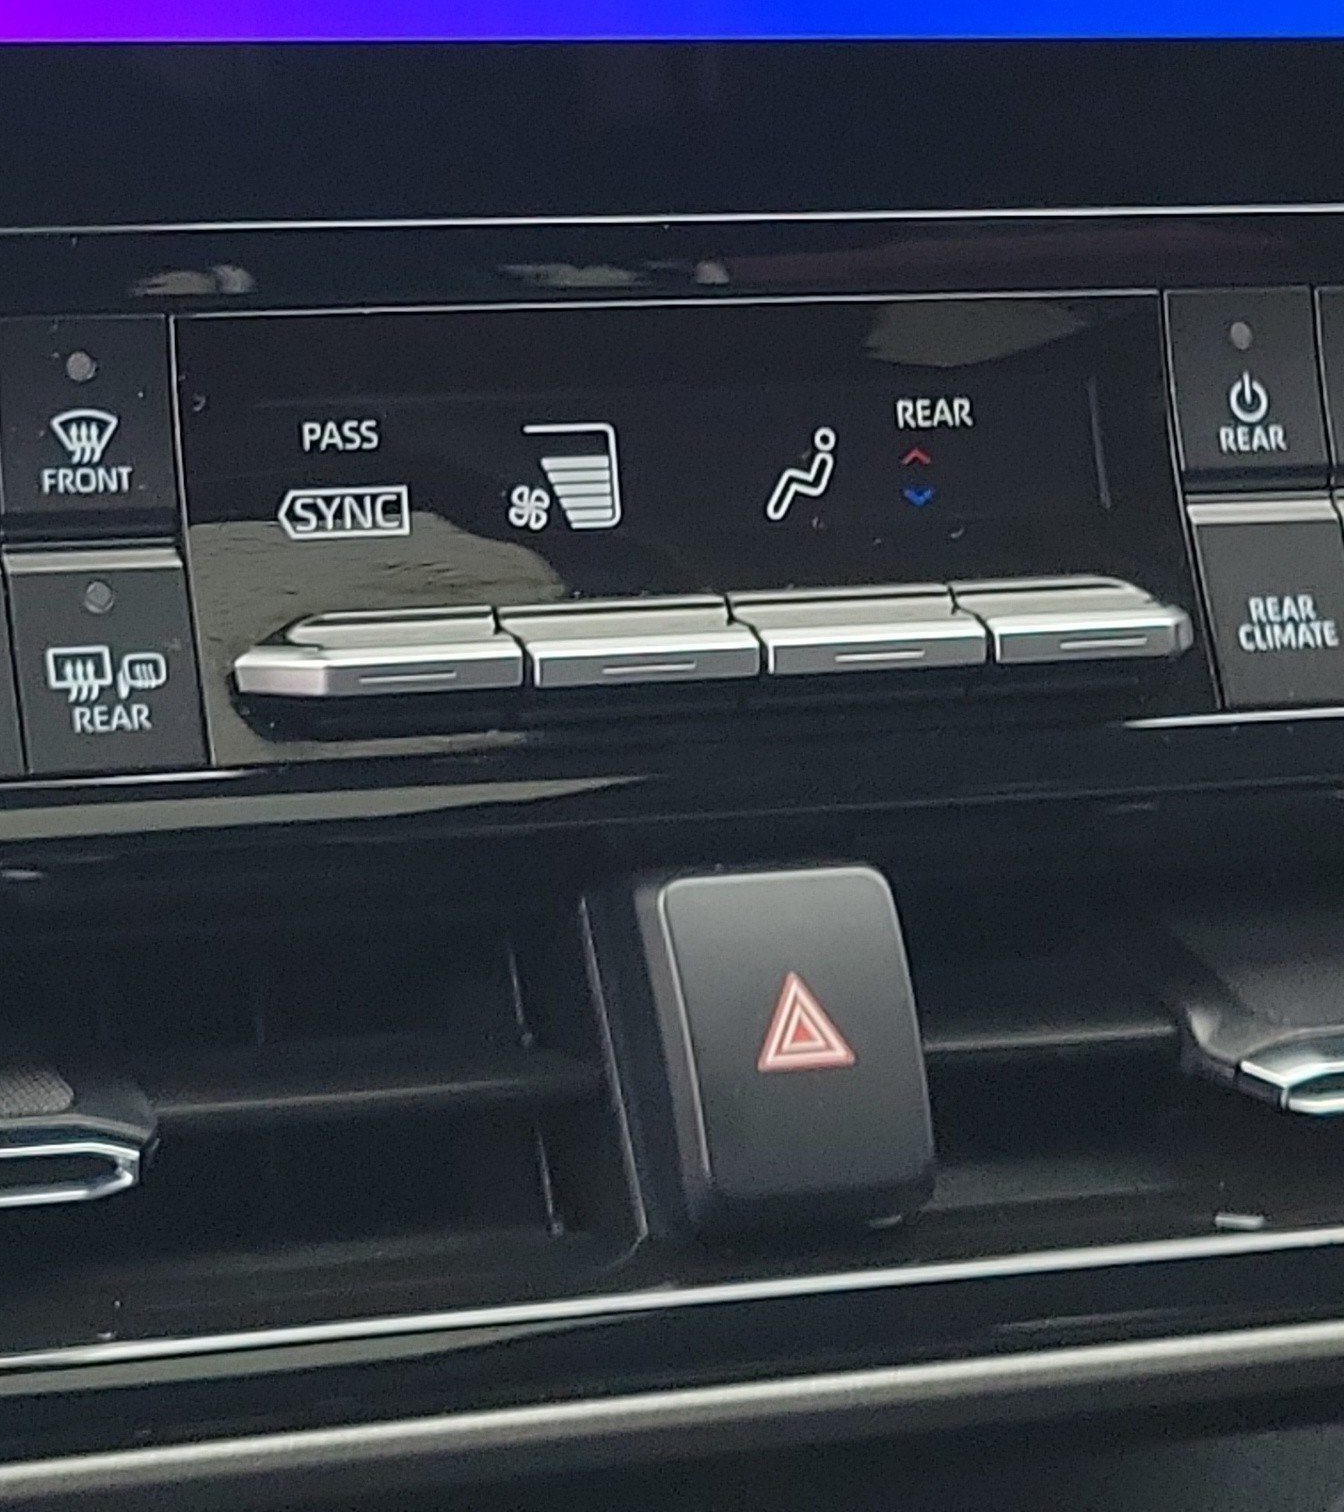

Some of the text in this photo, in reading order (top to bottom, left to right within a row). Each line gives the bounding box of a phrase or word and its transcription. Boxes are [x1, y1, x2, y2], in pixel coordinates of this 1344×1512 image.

[897, 397, 974, 429] REAR
[302, 420, 379, 453] PASS
[1219, 425, 1287, 453] REAR
[42, 467, 132, 494] FRONT
[292, 491, 402, 532] SYNC
[1249, 595, 1317, 623] REAR
[1238, 619, 1339, 652] CLIMATE
[73, 705, 152, 733] REAR
